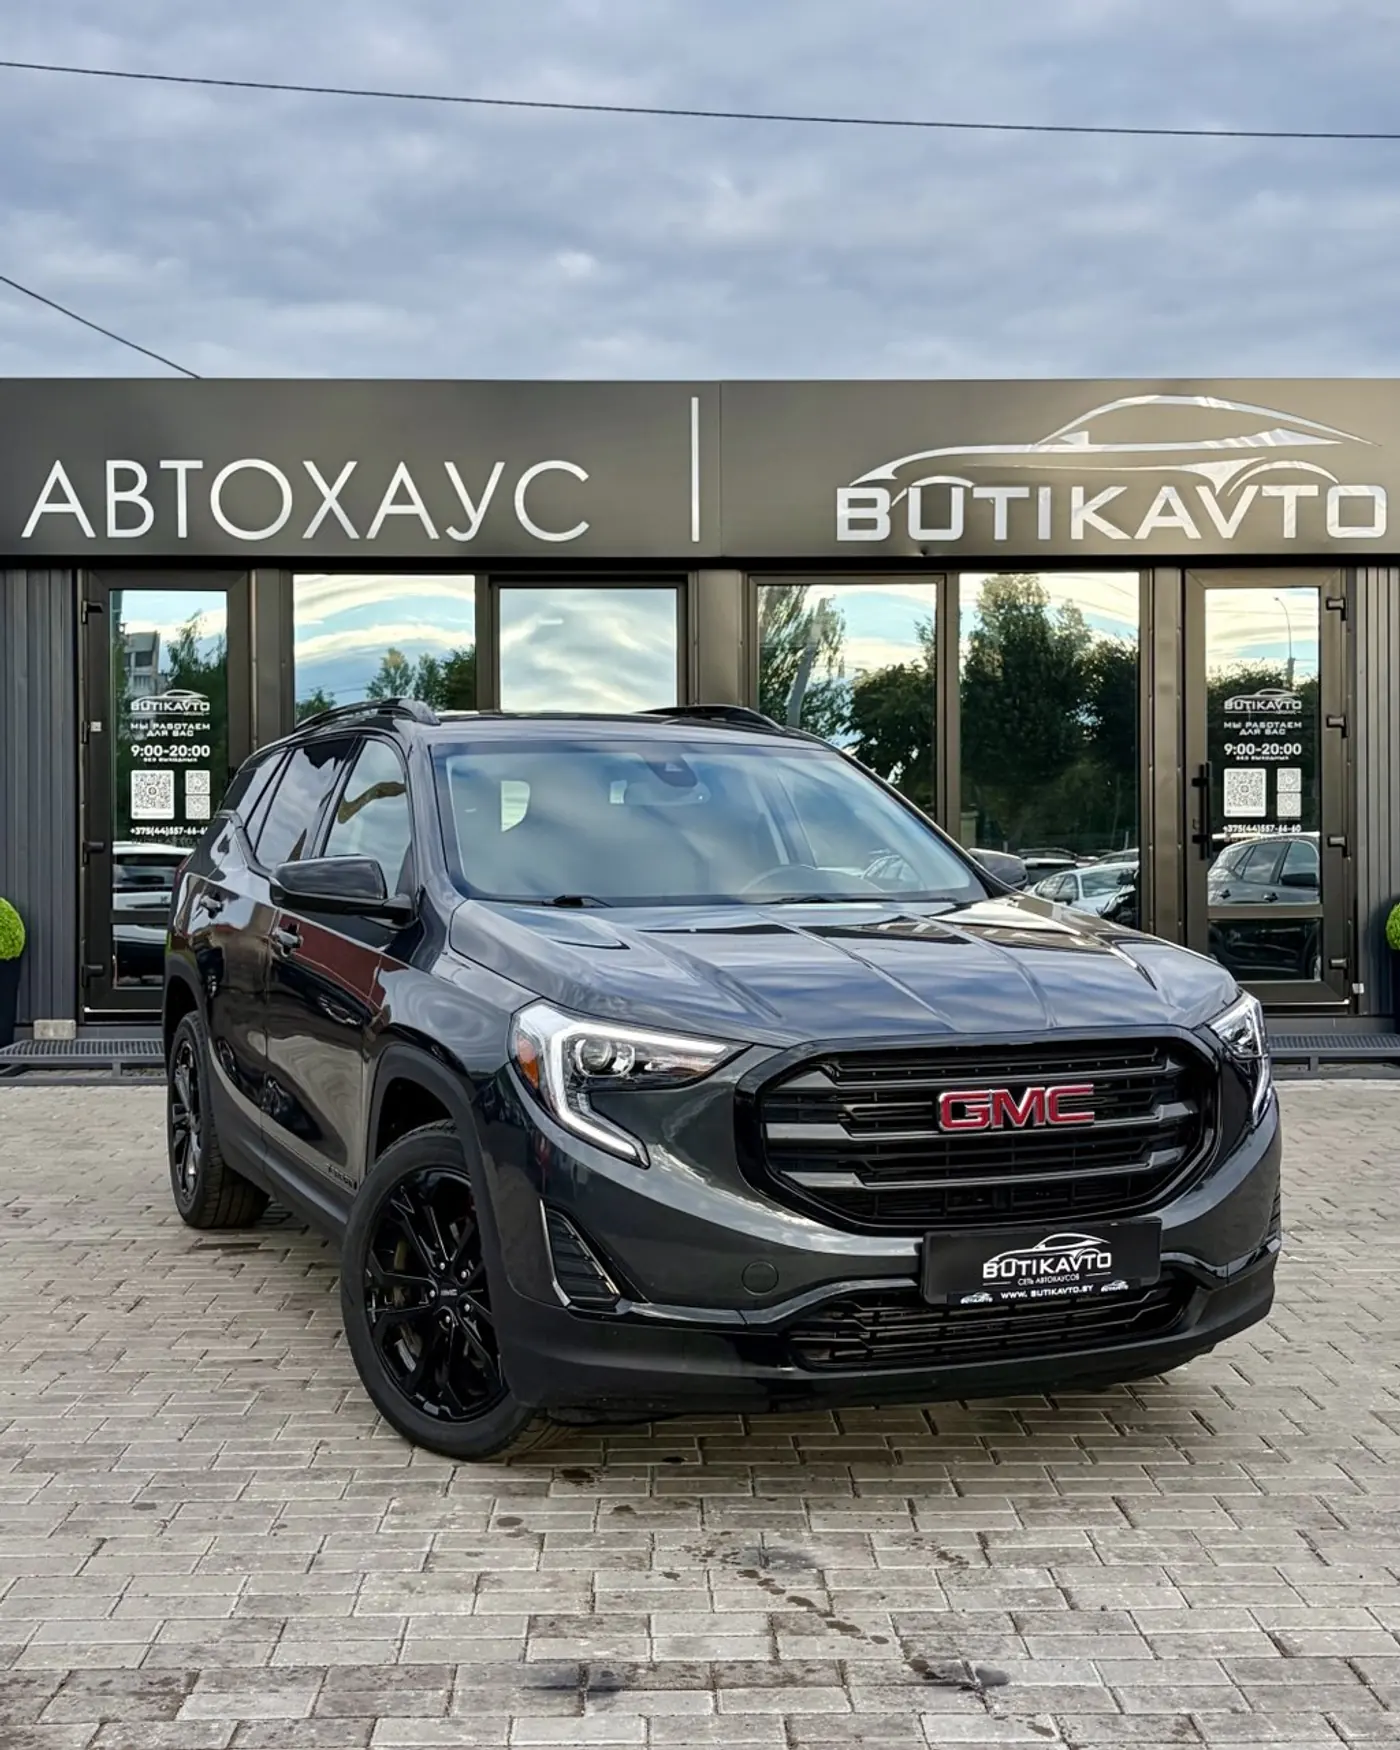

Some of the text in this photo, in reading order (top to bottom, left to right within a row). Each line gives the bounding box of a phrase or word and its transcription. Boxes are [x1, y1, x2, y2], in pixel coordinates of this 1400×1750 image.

[21, 458, 590, 543] АВТОХАУС
[836, 484, 1387, 542] BUTIKAVTO
[131, 701, 211, 711] BUTIKAVTO
[1223, 700, 1302, 710] BUTIKAVTO
[130, 744, 211, 757] 9:00-20:00
[1223, 743, 1302, 755] 9:00-20:00
[938, 1084, 1095, 1131] GMC
[982, 1252, 1112, 1279] BUTIKAVTO
[1030, 1284, 1094, 1298] BUTIKAVTO.BY
